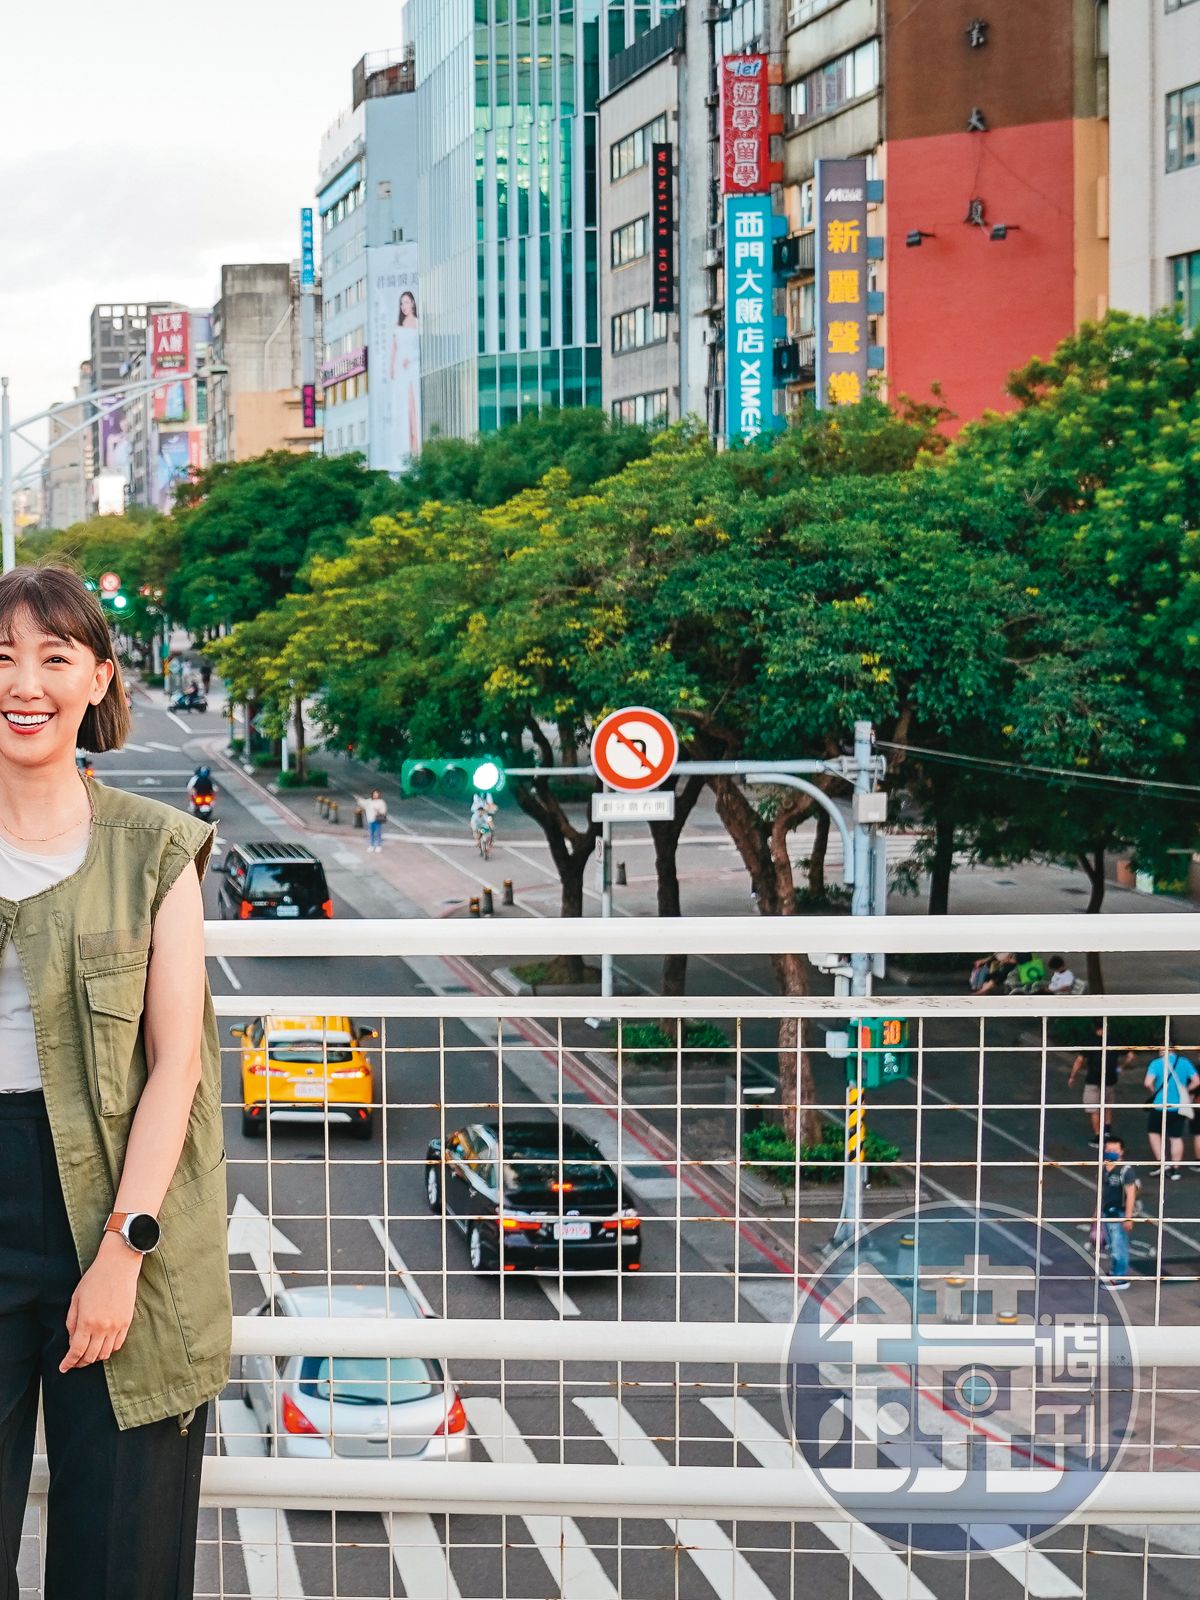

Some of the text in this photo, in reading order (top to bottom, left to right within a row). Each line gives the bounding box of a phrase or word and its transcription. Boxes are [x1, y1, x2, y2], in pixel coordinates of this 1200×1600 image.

[657, 151, 667, 305] WONSTAR HOTEL
[735, 211, 764, 354] 西門大飯店
